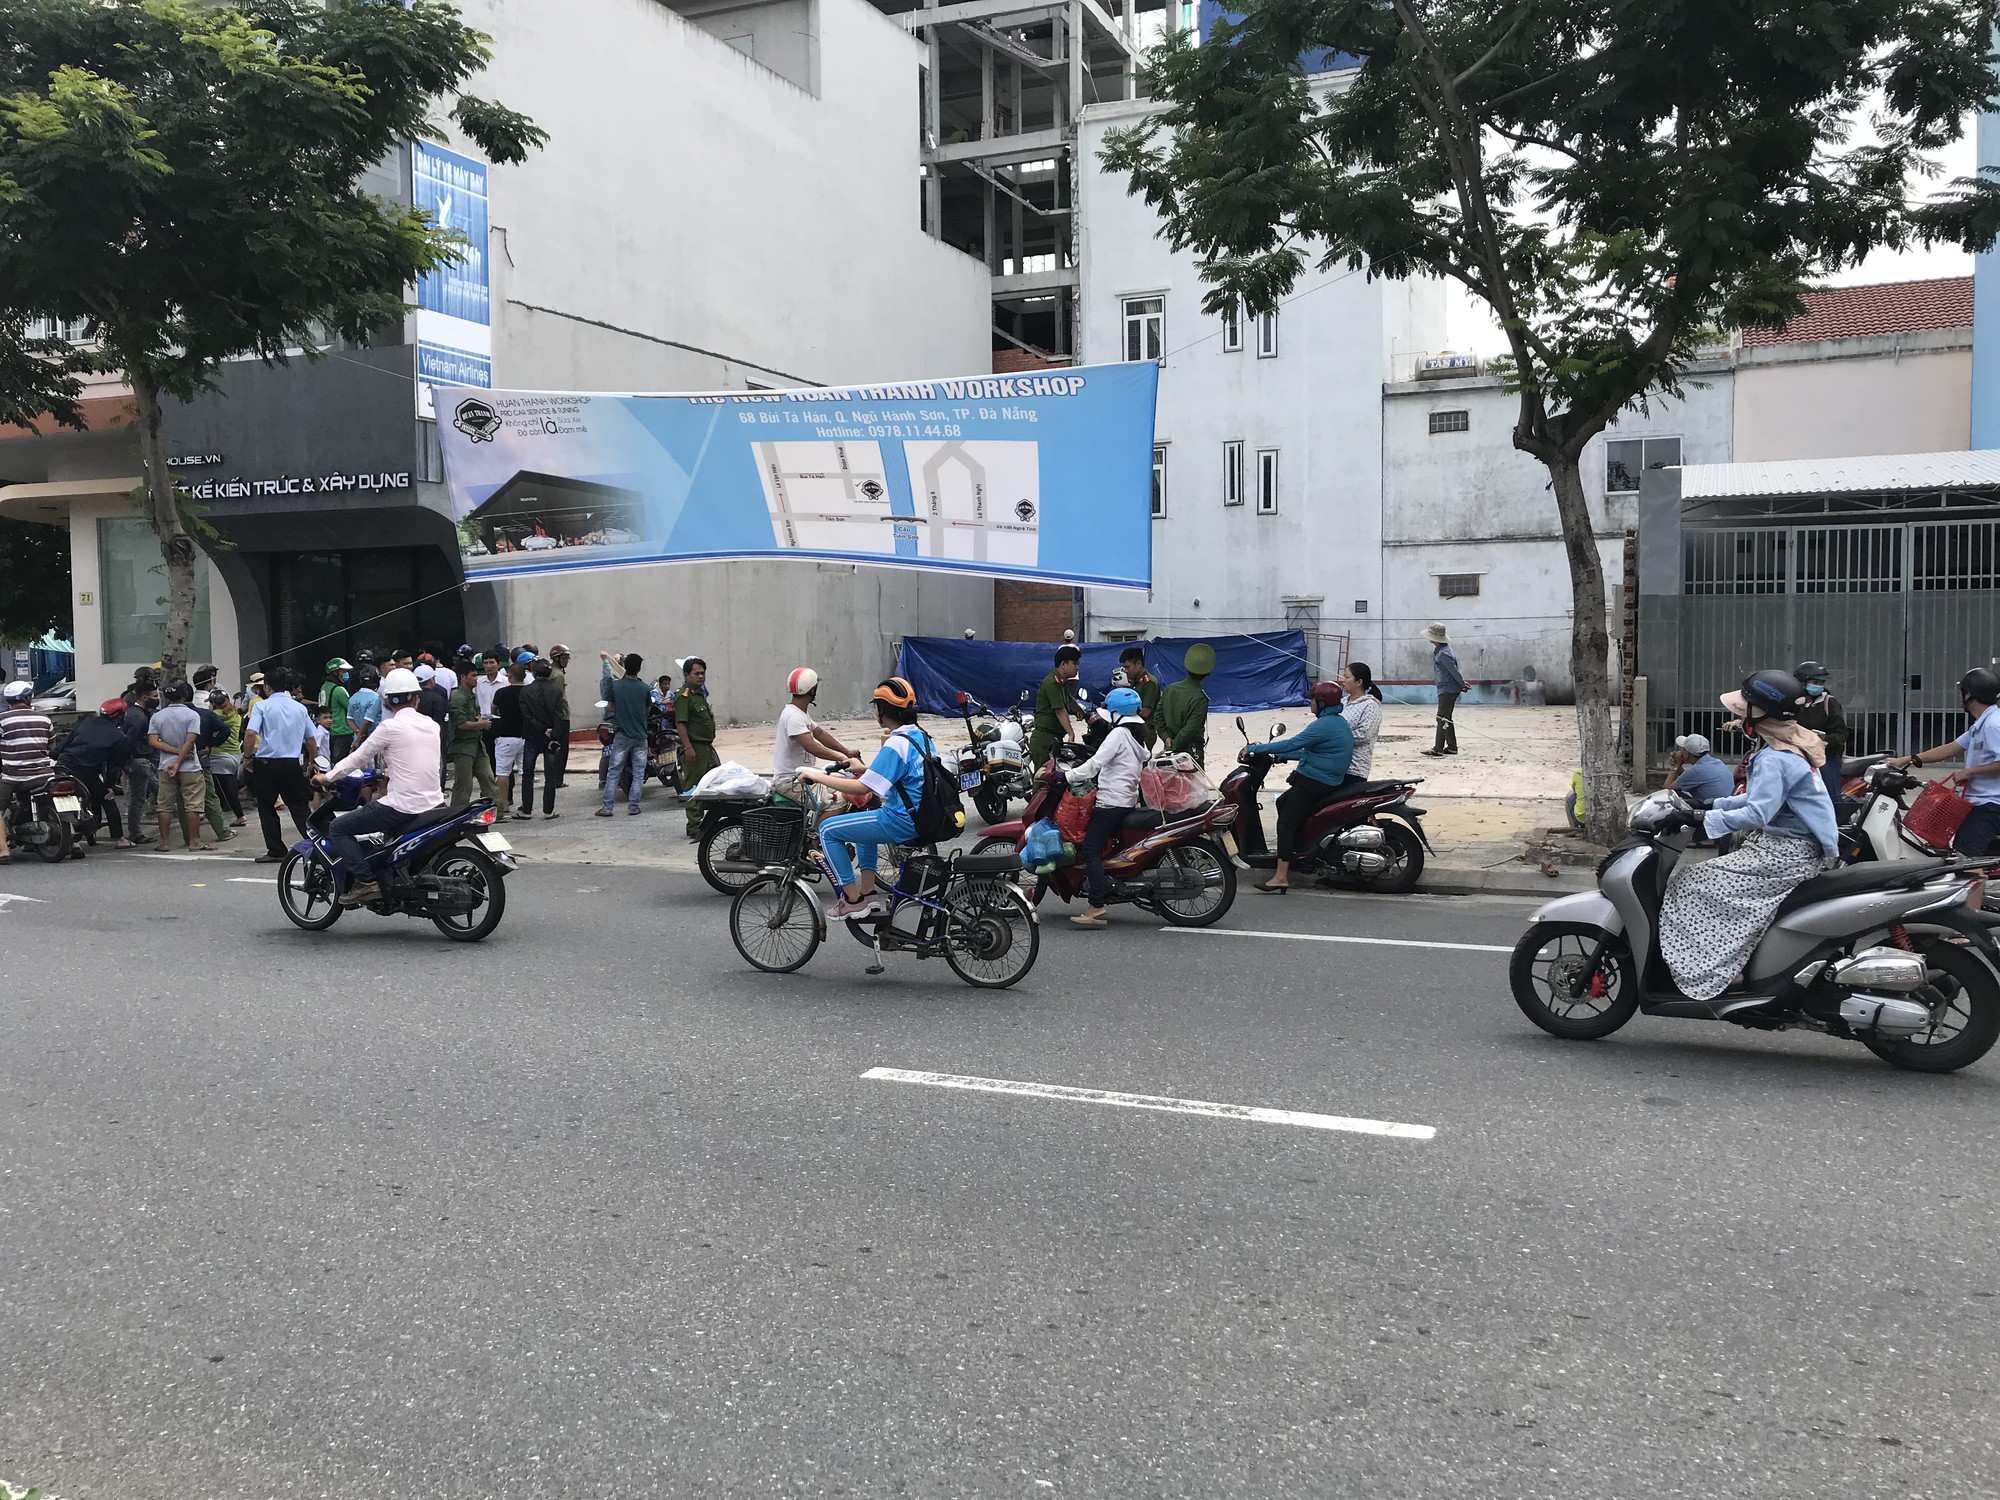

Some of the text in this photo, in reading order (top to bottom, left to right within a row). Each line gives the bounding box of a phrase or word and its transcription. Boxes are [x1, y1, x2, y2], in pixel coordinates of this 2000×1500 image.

[421, 352, 489, 382] Vietnam Airlines
[939, 376, 1086, 400] WORKSHOP
[549, 396, 591, 405] WORKSHOP
[557, 406, 580, 414] TUNING
[738, 412, 756, 424] 68
[834, 410, 849, 423] Q.
[539, 416, 559, 435] là
[815, 424, 961, 438] Hotline: 0978.11.44.68
[192, 478, 213, 499] KẾ
[215, 476, 250, 498] KIẾN
[253, 474, 300, 496] TRÚC
[302, 478, 315, 493] &
[319, 471, 356, 491] XÂY
[358, 472, 409, 493] DỰNG
[1005, 750, 1020, 760] POLICE
